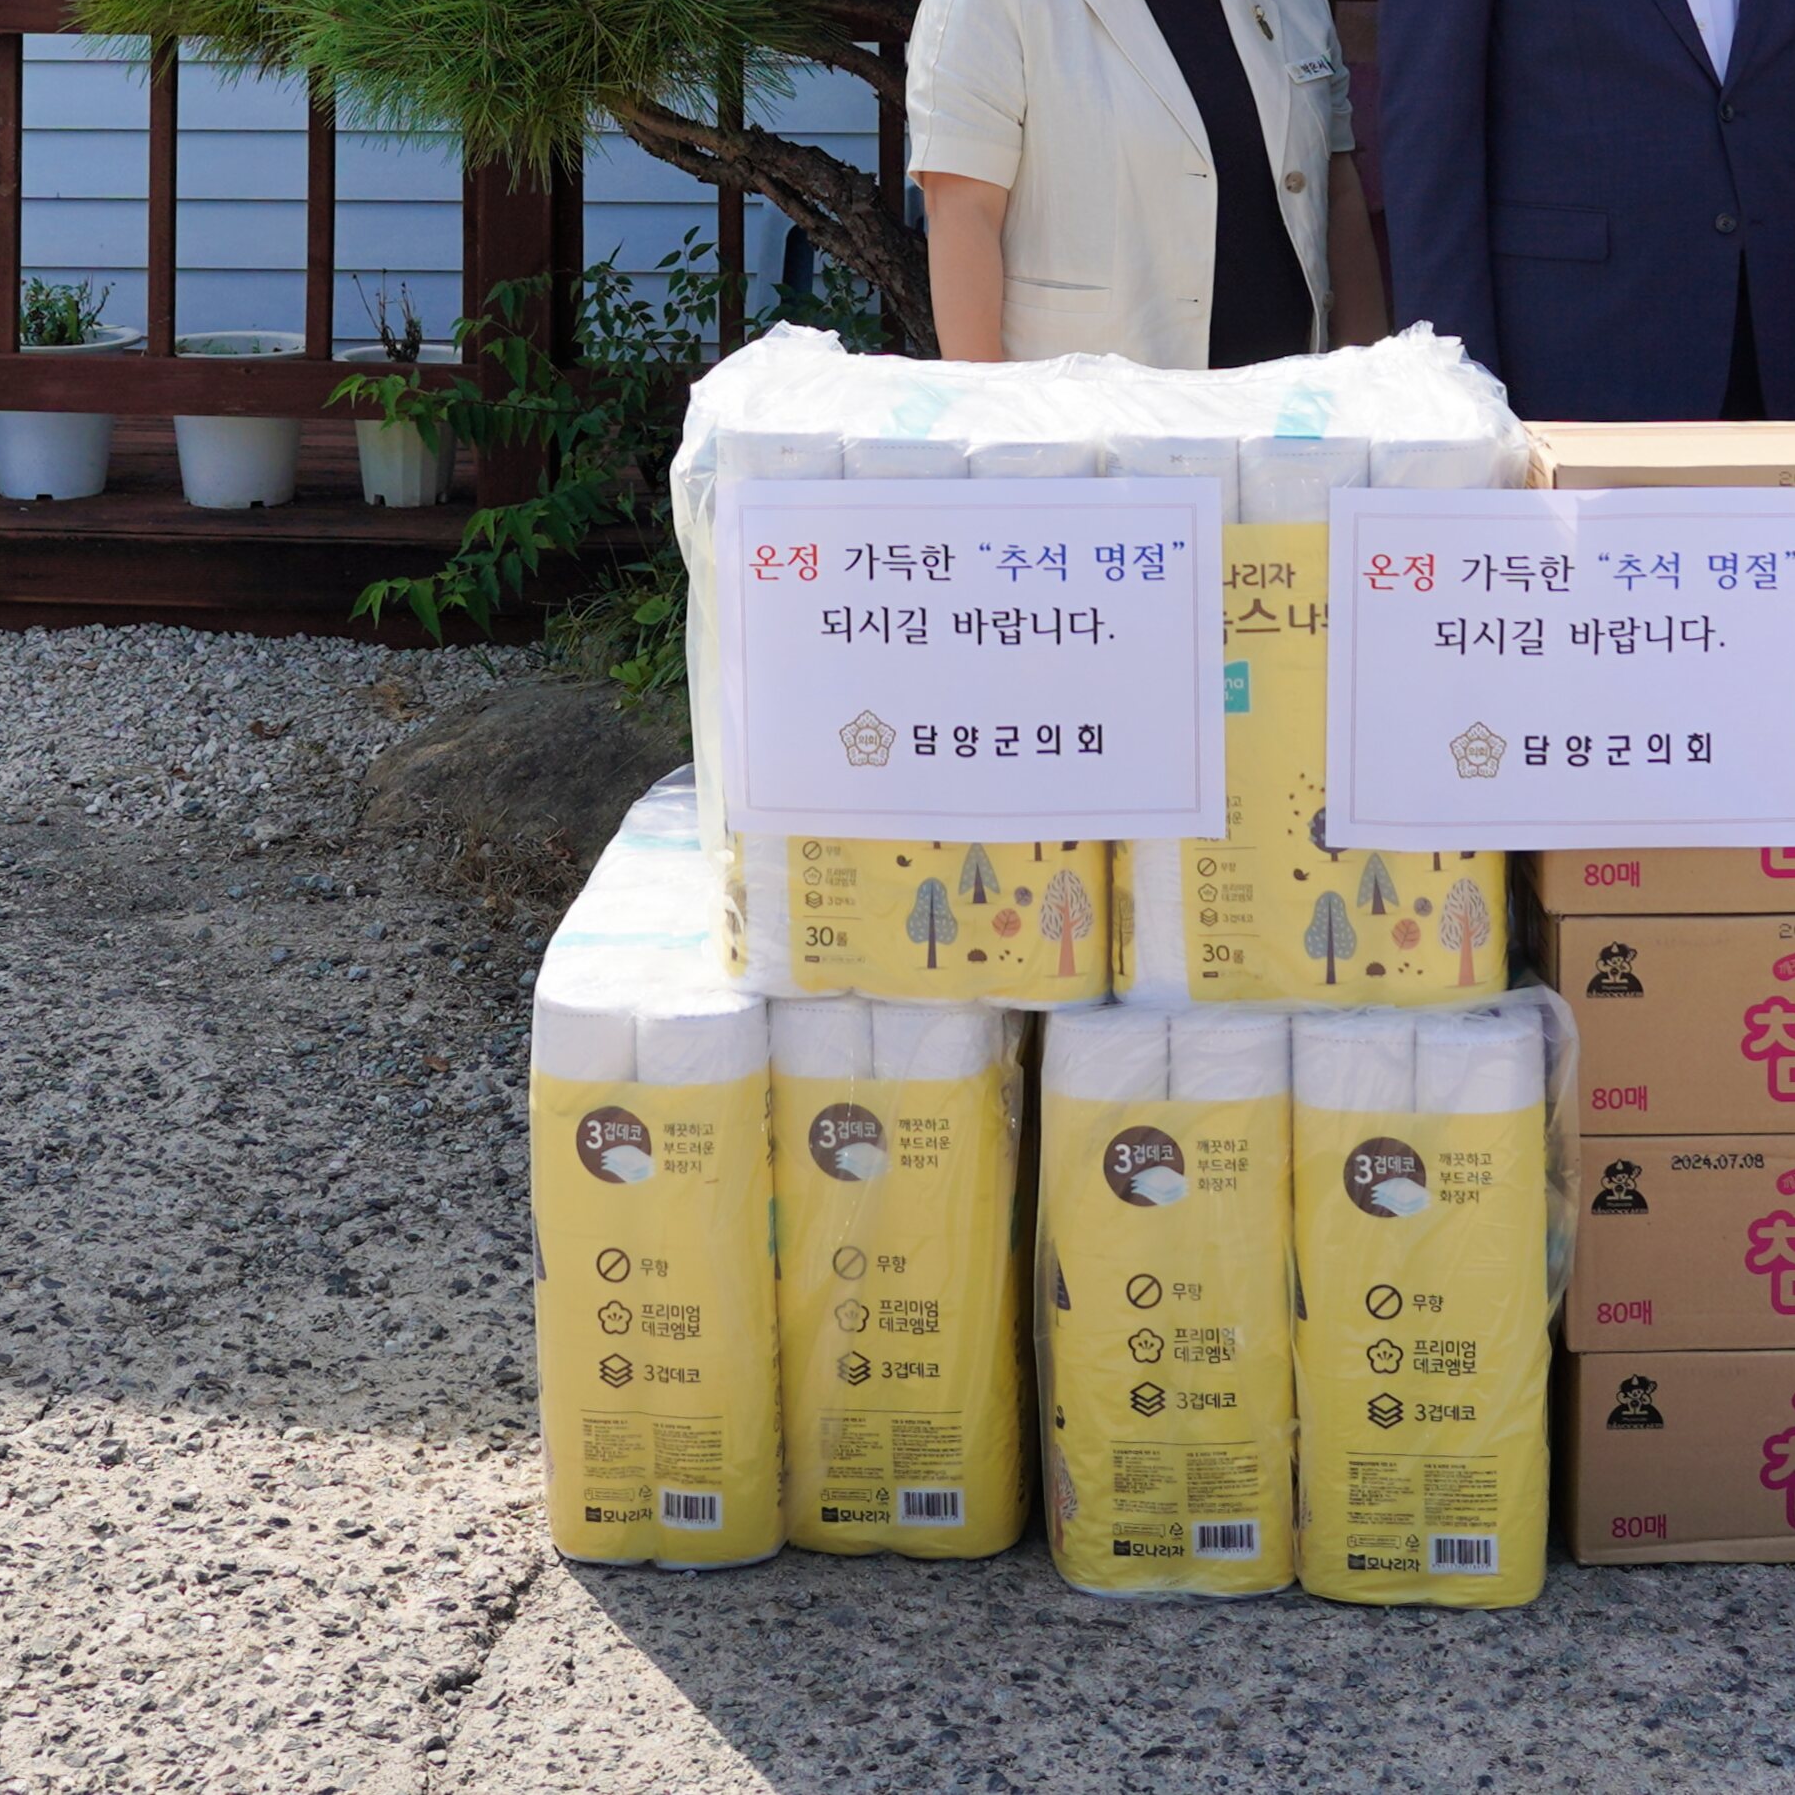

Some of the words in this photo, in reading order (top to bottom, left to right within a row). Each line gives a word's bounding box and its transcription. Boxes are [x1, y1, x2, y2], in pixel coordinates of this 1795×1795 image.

[748, 543, 819, 582] 온정
[844, 543, 955, 582] 가득한
[978, 541, 1069, 582] “추석
[1094, 540, 1185, 581] 명절”
[1362, 553, 1435, 592] 온정
[1460, 553, 1575, 592] 가득한
[1598, 551, 1681, 592] “추석
[821, 607, 929, 646] 되시길
[953, 605, 1116, 646] 바랍니다.
[1434, 616, 1545, 656] 되시길
[1570, 615, 1726, 656] 바랍니다.
[1583, 859, 1642, 888] 80매
[1592, 1085, 1647, 1111] 80매
[663, 1121, 715, 1137] 깨끗하고
[818, 1117, 876, 1151] 3겹데코
[898, 1118, 950, 1132] 깨끗하고
[584, 1119, 642, 1151] 3겹데코
[898, 1136, 951, 1151] 부드러운
[663, 1141, 715, 1157] 부드러운
[663, 1159, 702, 1174] 화장지
[899, 1154, 939, 1169] 화장지
[1438, 1151, 1493, 1166] 깨끗하고
[1671, 1154, 1765, 1170] 2024.07.08
[1354, 1153, 1416, 1186] 3겹데코
[1439, 1171, 1494, 1186] 부드러운
[1439, 1190, 1480, 1204] 화장지
[640, 1256, 669, 1278] 무향
[1412, 1293, 1445, 1314] 무향
[1597, 1300, 1652, 1325] 80매
[640, 1305, 700, 1321] 프리미엄
[640, 1321, 701, 1339] 데코엠보
[1413, 1339, 1476, 1358] 프리미엄
[643, 1364, 701, 1385] 3겹데코
[881, 1358, 941, 1380] 3겹데코
[1413, 1358, 1477, 1376] 데코엠보
[1415, 1403, 1477, 1423] 3겹데코
[602, 1508, 653, 1525] 모나리자
[839, 1508, 891, 1525] 모나리자
[1612, 1514, 1667, 1539] 80매
[1132, 1543, 1185, 1559] 모나리자
[1366, 1555, 1421, 1573] 모나리자
